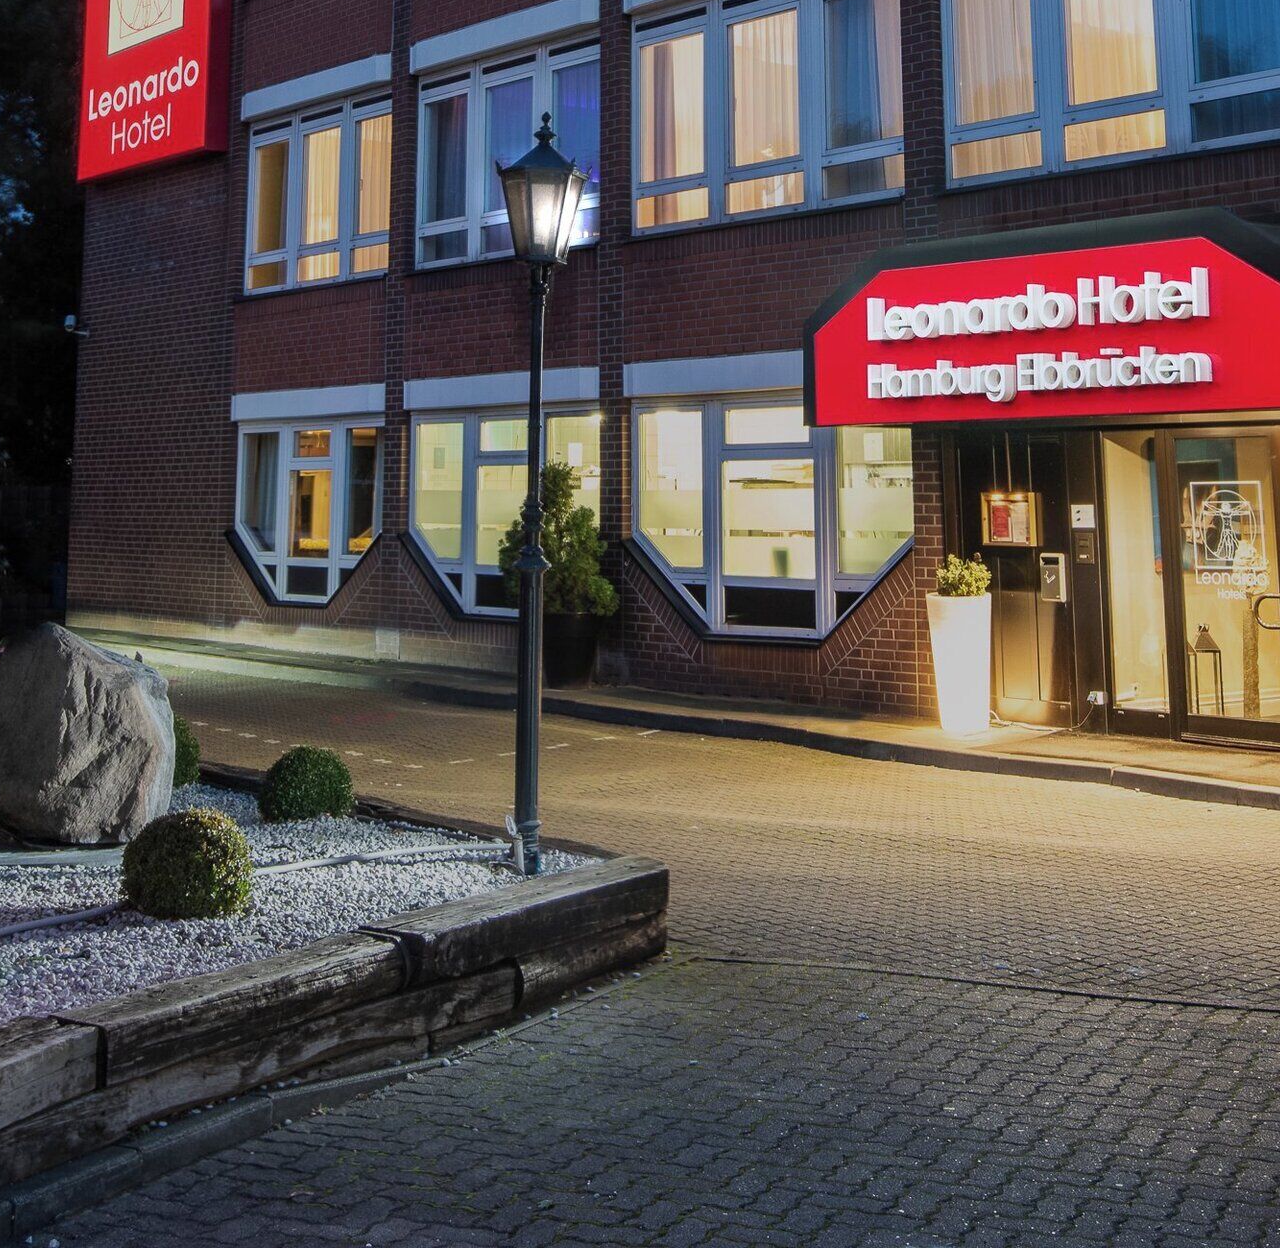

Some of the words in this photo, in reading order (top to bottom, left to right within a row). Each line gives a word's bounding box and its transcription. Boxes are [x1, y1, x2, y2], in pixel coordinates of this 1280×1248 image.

[88, 56, 200, 122] Leonardo
[111, 102, 172, 155] Hotel
[867, 283, 1076, 341] Leonardo
[1077, 266, 1210, 326] Hotel
[867, 359, 1016, 403] Hamburg
[1016, 345, 1213, 392] Elbbrücken
[1195, 570, 1269, 586] Leonardo
[1217, 588, 1247, 600] Hotels
